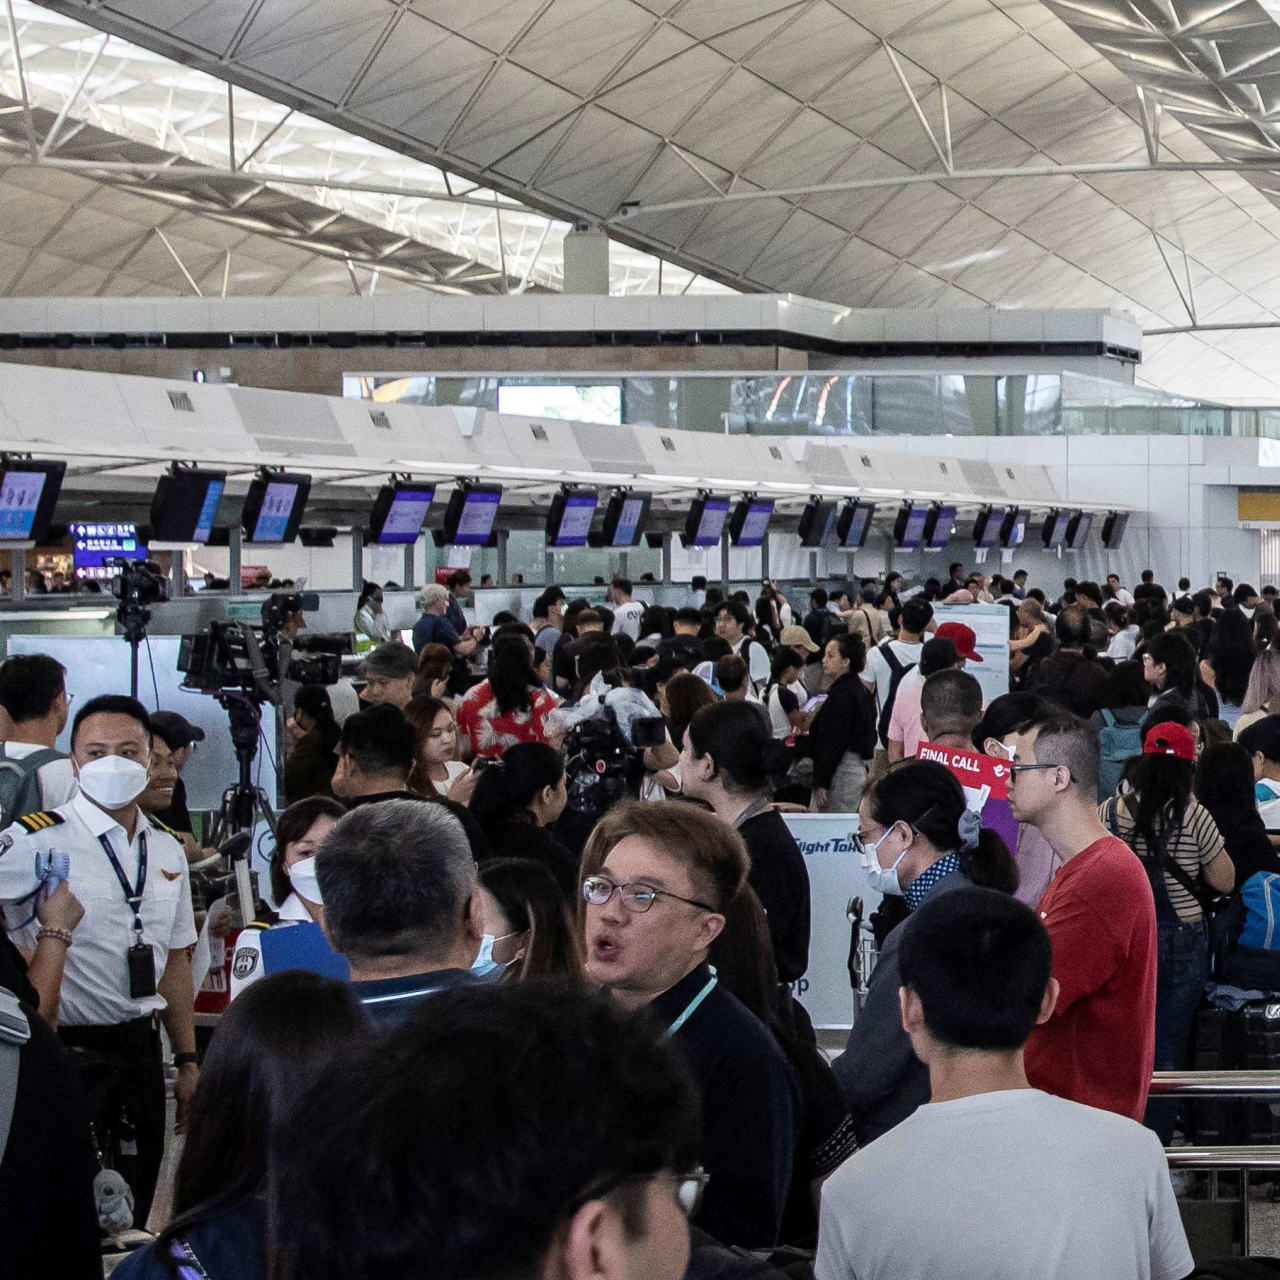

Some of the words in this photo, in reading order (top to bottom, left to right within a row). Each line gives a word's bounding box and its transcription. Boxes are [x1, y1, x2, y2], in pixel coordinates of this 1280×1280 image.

[920, 748, 950, 765] FINAL
[952, 755, 980, 772] CALL
[795, 838, 831, 855] light
[831, 838, 864, 853] Tok
